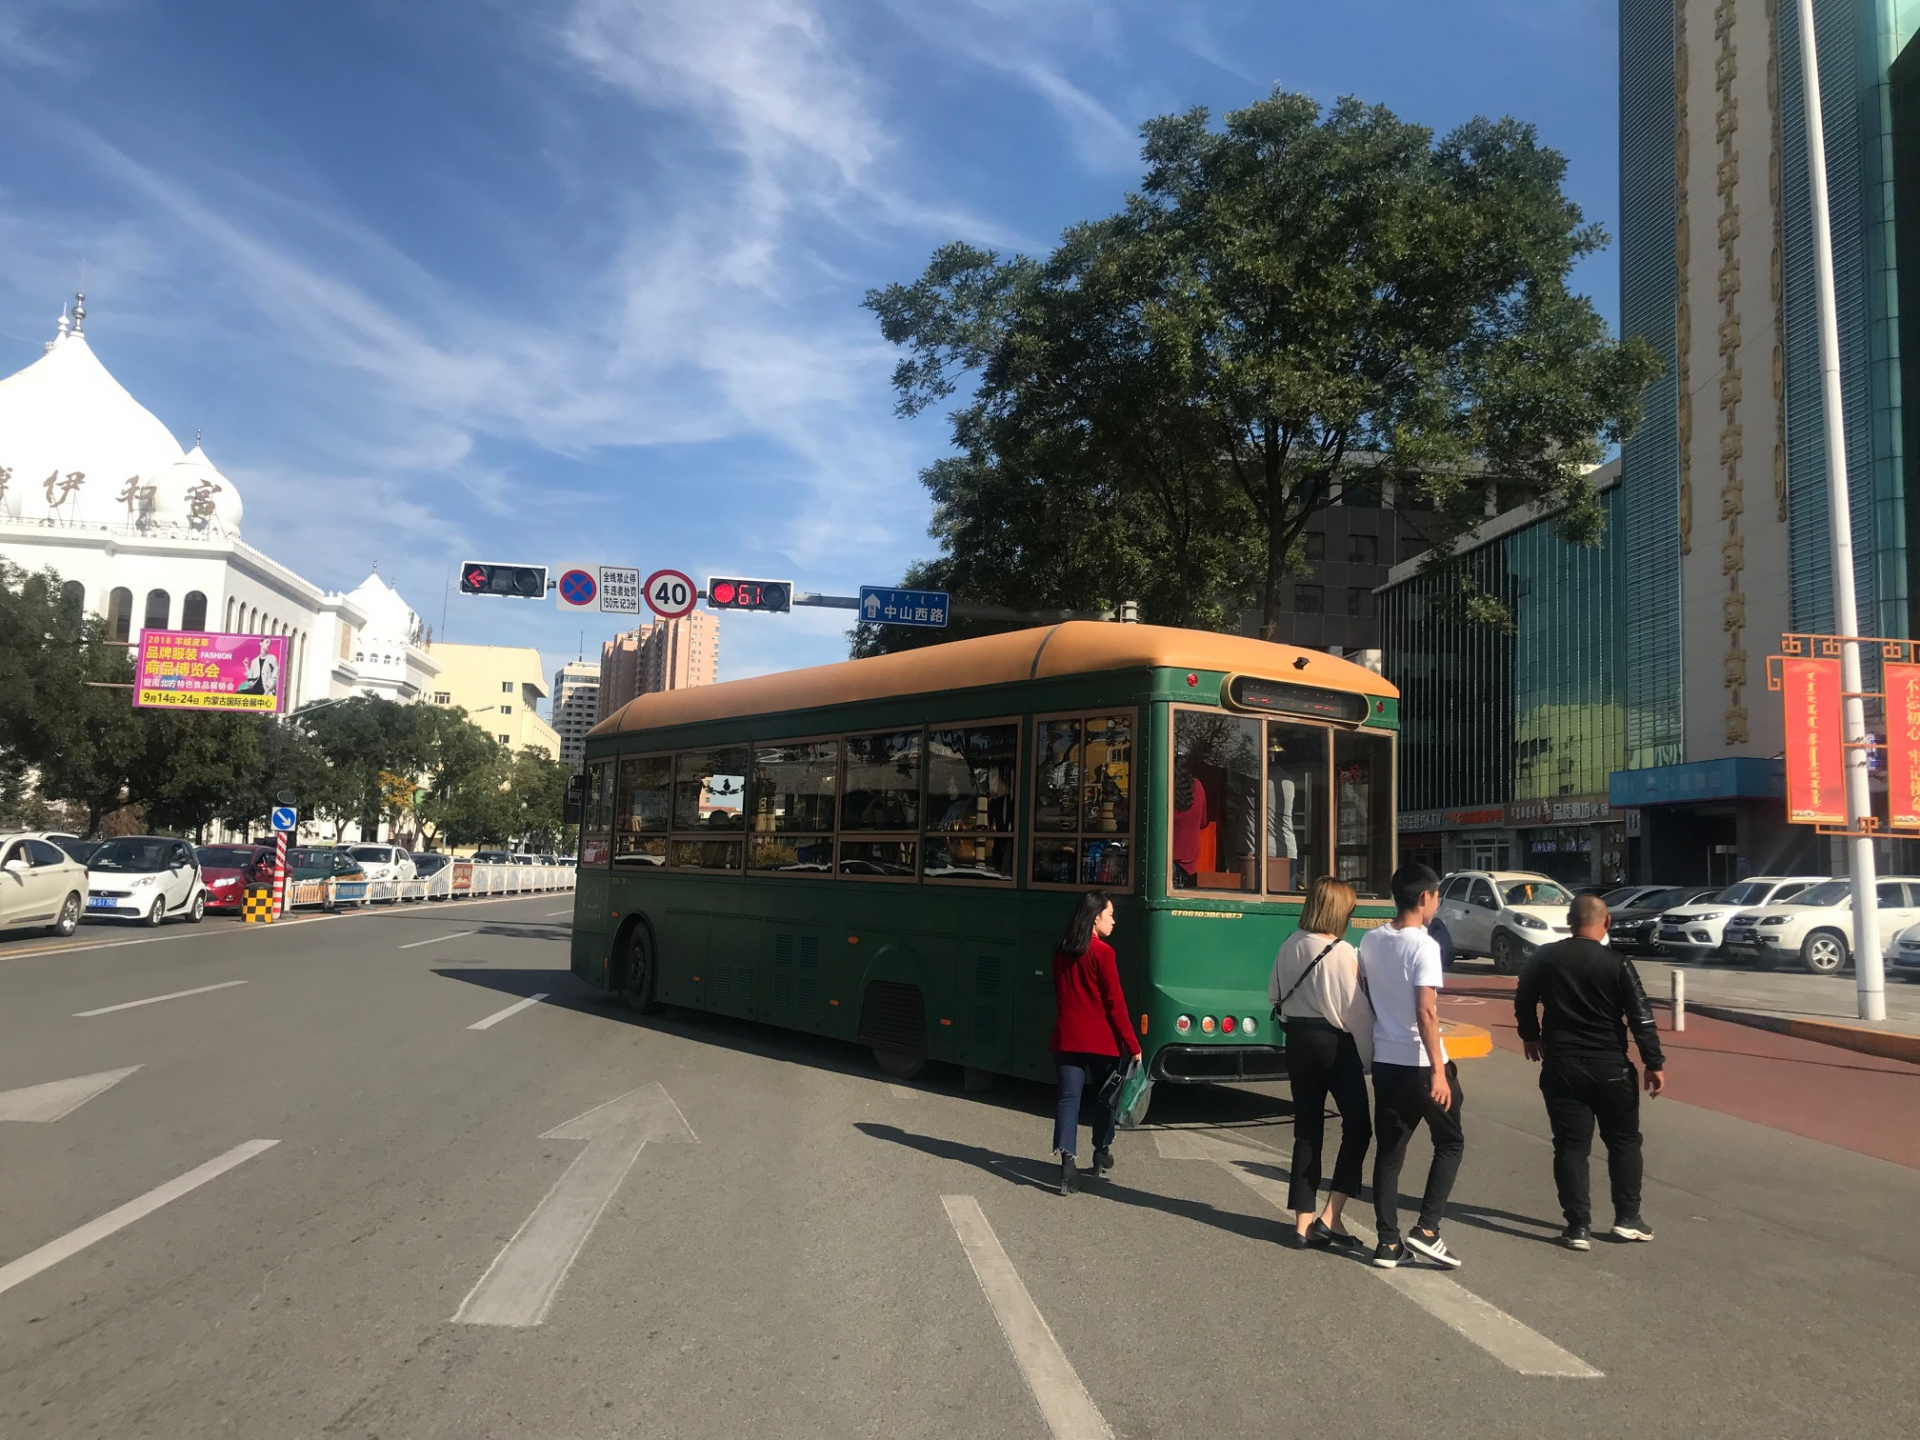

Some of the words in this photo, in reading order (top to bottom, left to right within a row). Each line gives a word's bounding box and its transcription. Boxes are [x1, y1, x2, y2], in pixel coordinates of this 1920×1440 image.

[655, 582, 687, 605] 40
[738, 584, 761, 605] 61
[884, 604, 944, 623] 中山西路
[148, 636, 171, 644] 2018
[146, 646, 198, 660] 品牌服装
[200, 652, 233, 660] FASHION
[145, 660, 220, 678] 商品博览会
[203, 697, 273, 708] 内蒙古国际会展中心
[1905, 678, 1920, 741] 不忘初心
